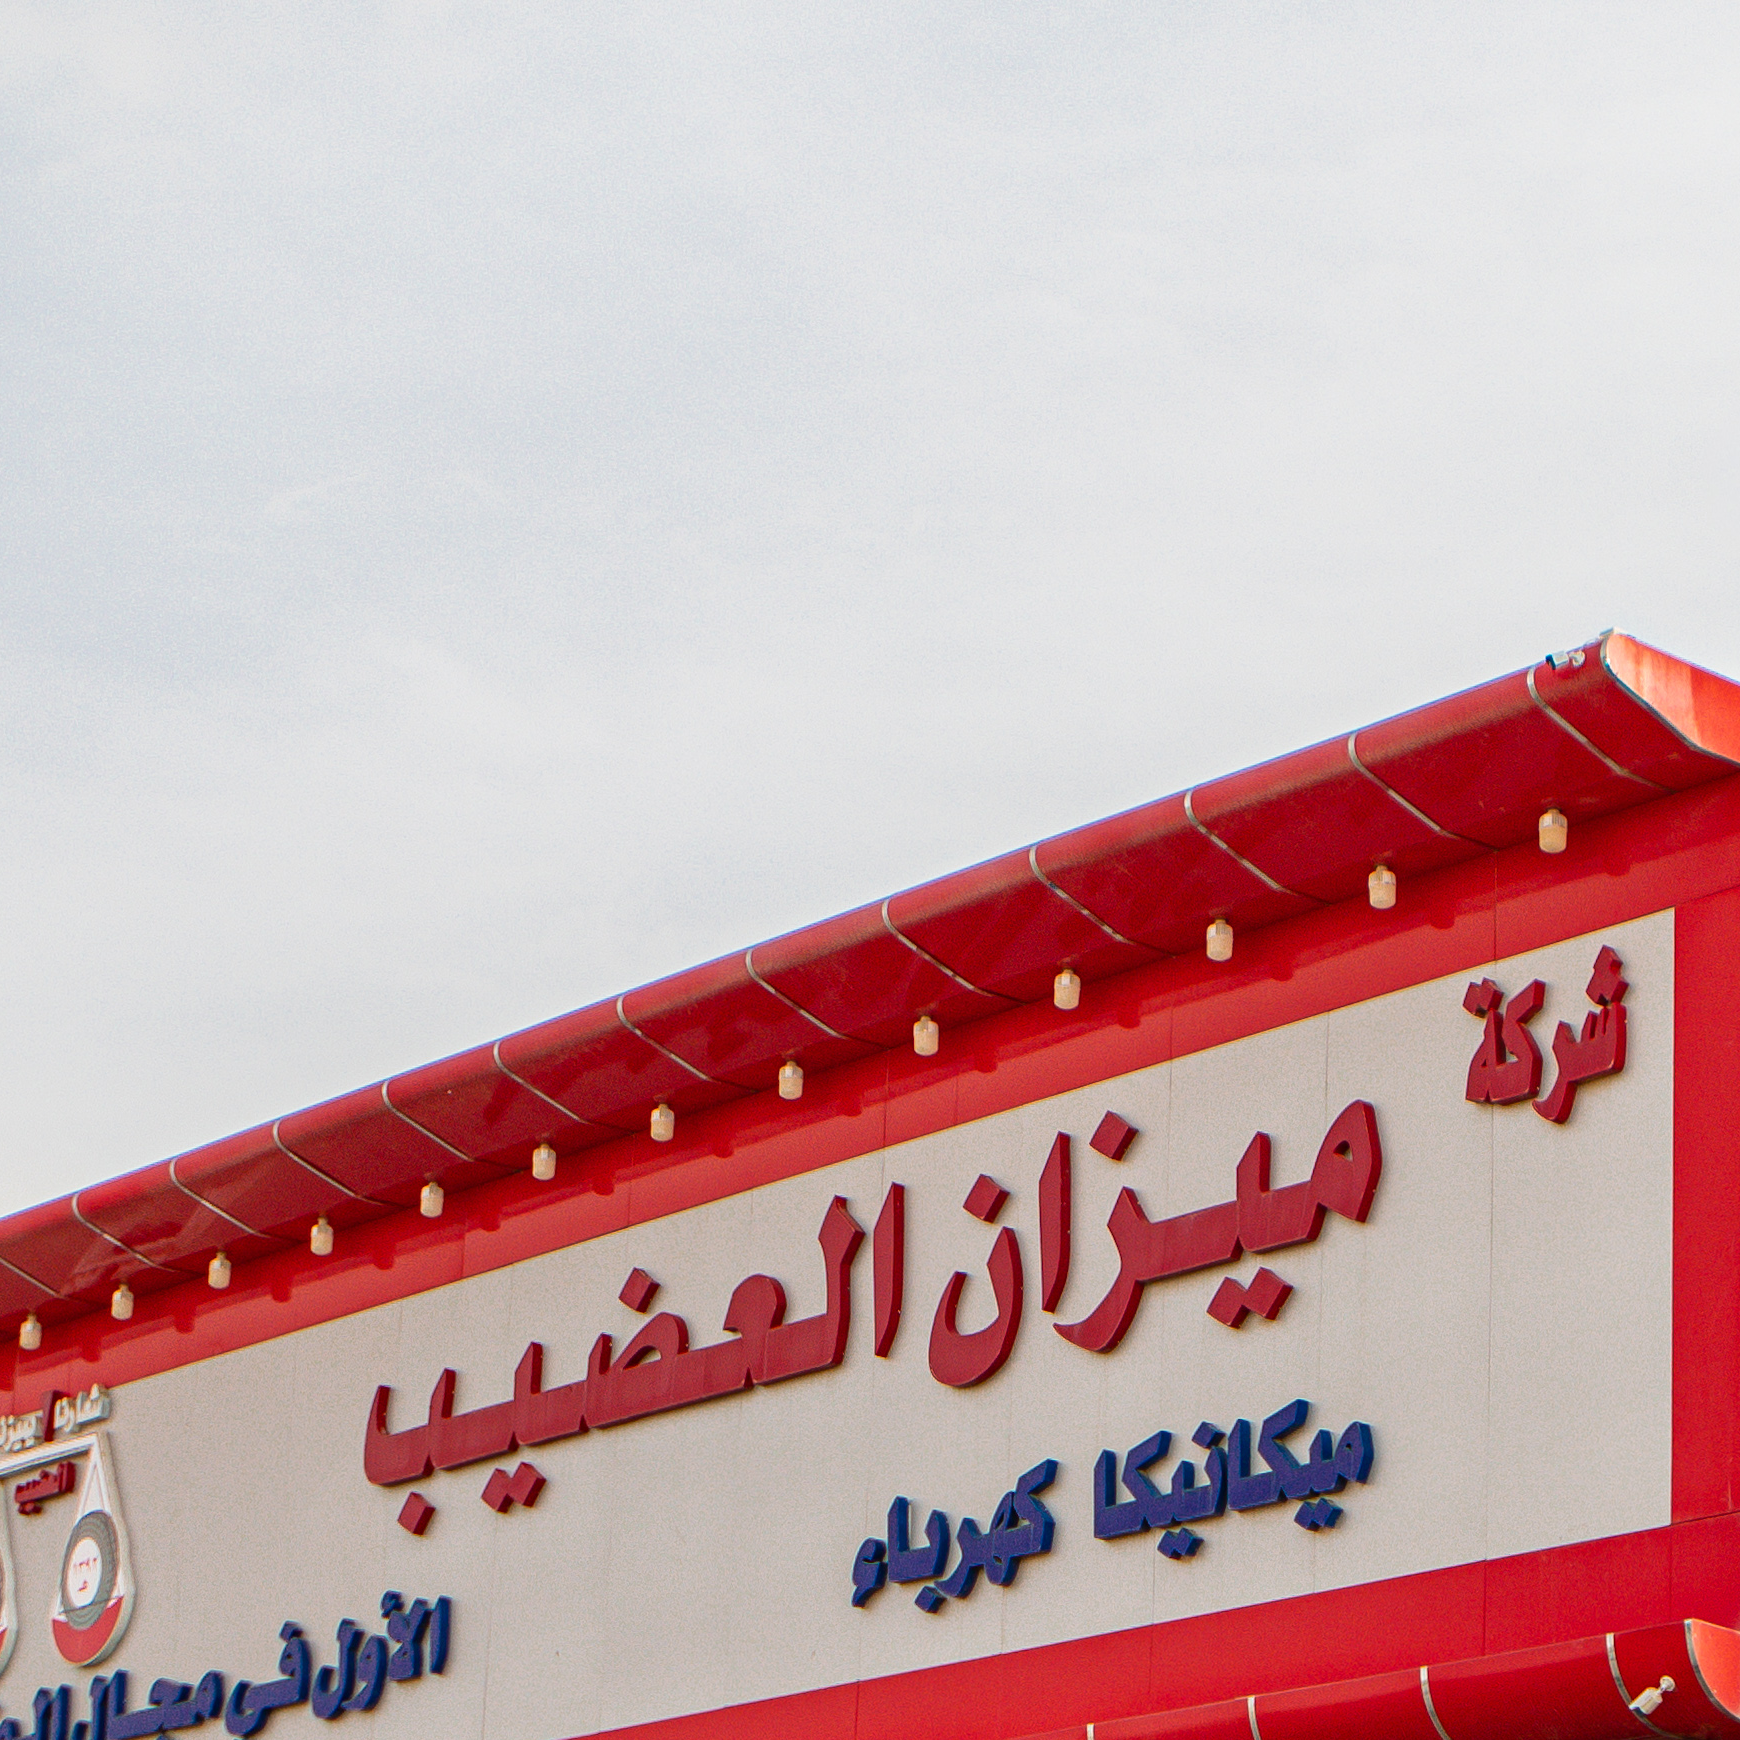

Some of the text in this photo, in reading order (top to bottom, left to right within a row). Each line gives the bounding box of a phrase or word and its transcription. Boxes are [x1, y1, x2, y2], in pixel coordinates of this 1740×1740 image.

[364, 944, 1630, 1535] شركة ميزان العضيب
[853, 1398, 1374, 1612] ميكانيكا كهرباء
[312, 1590, 452, 1719] الأول
